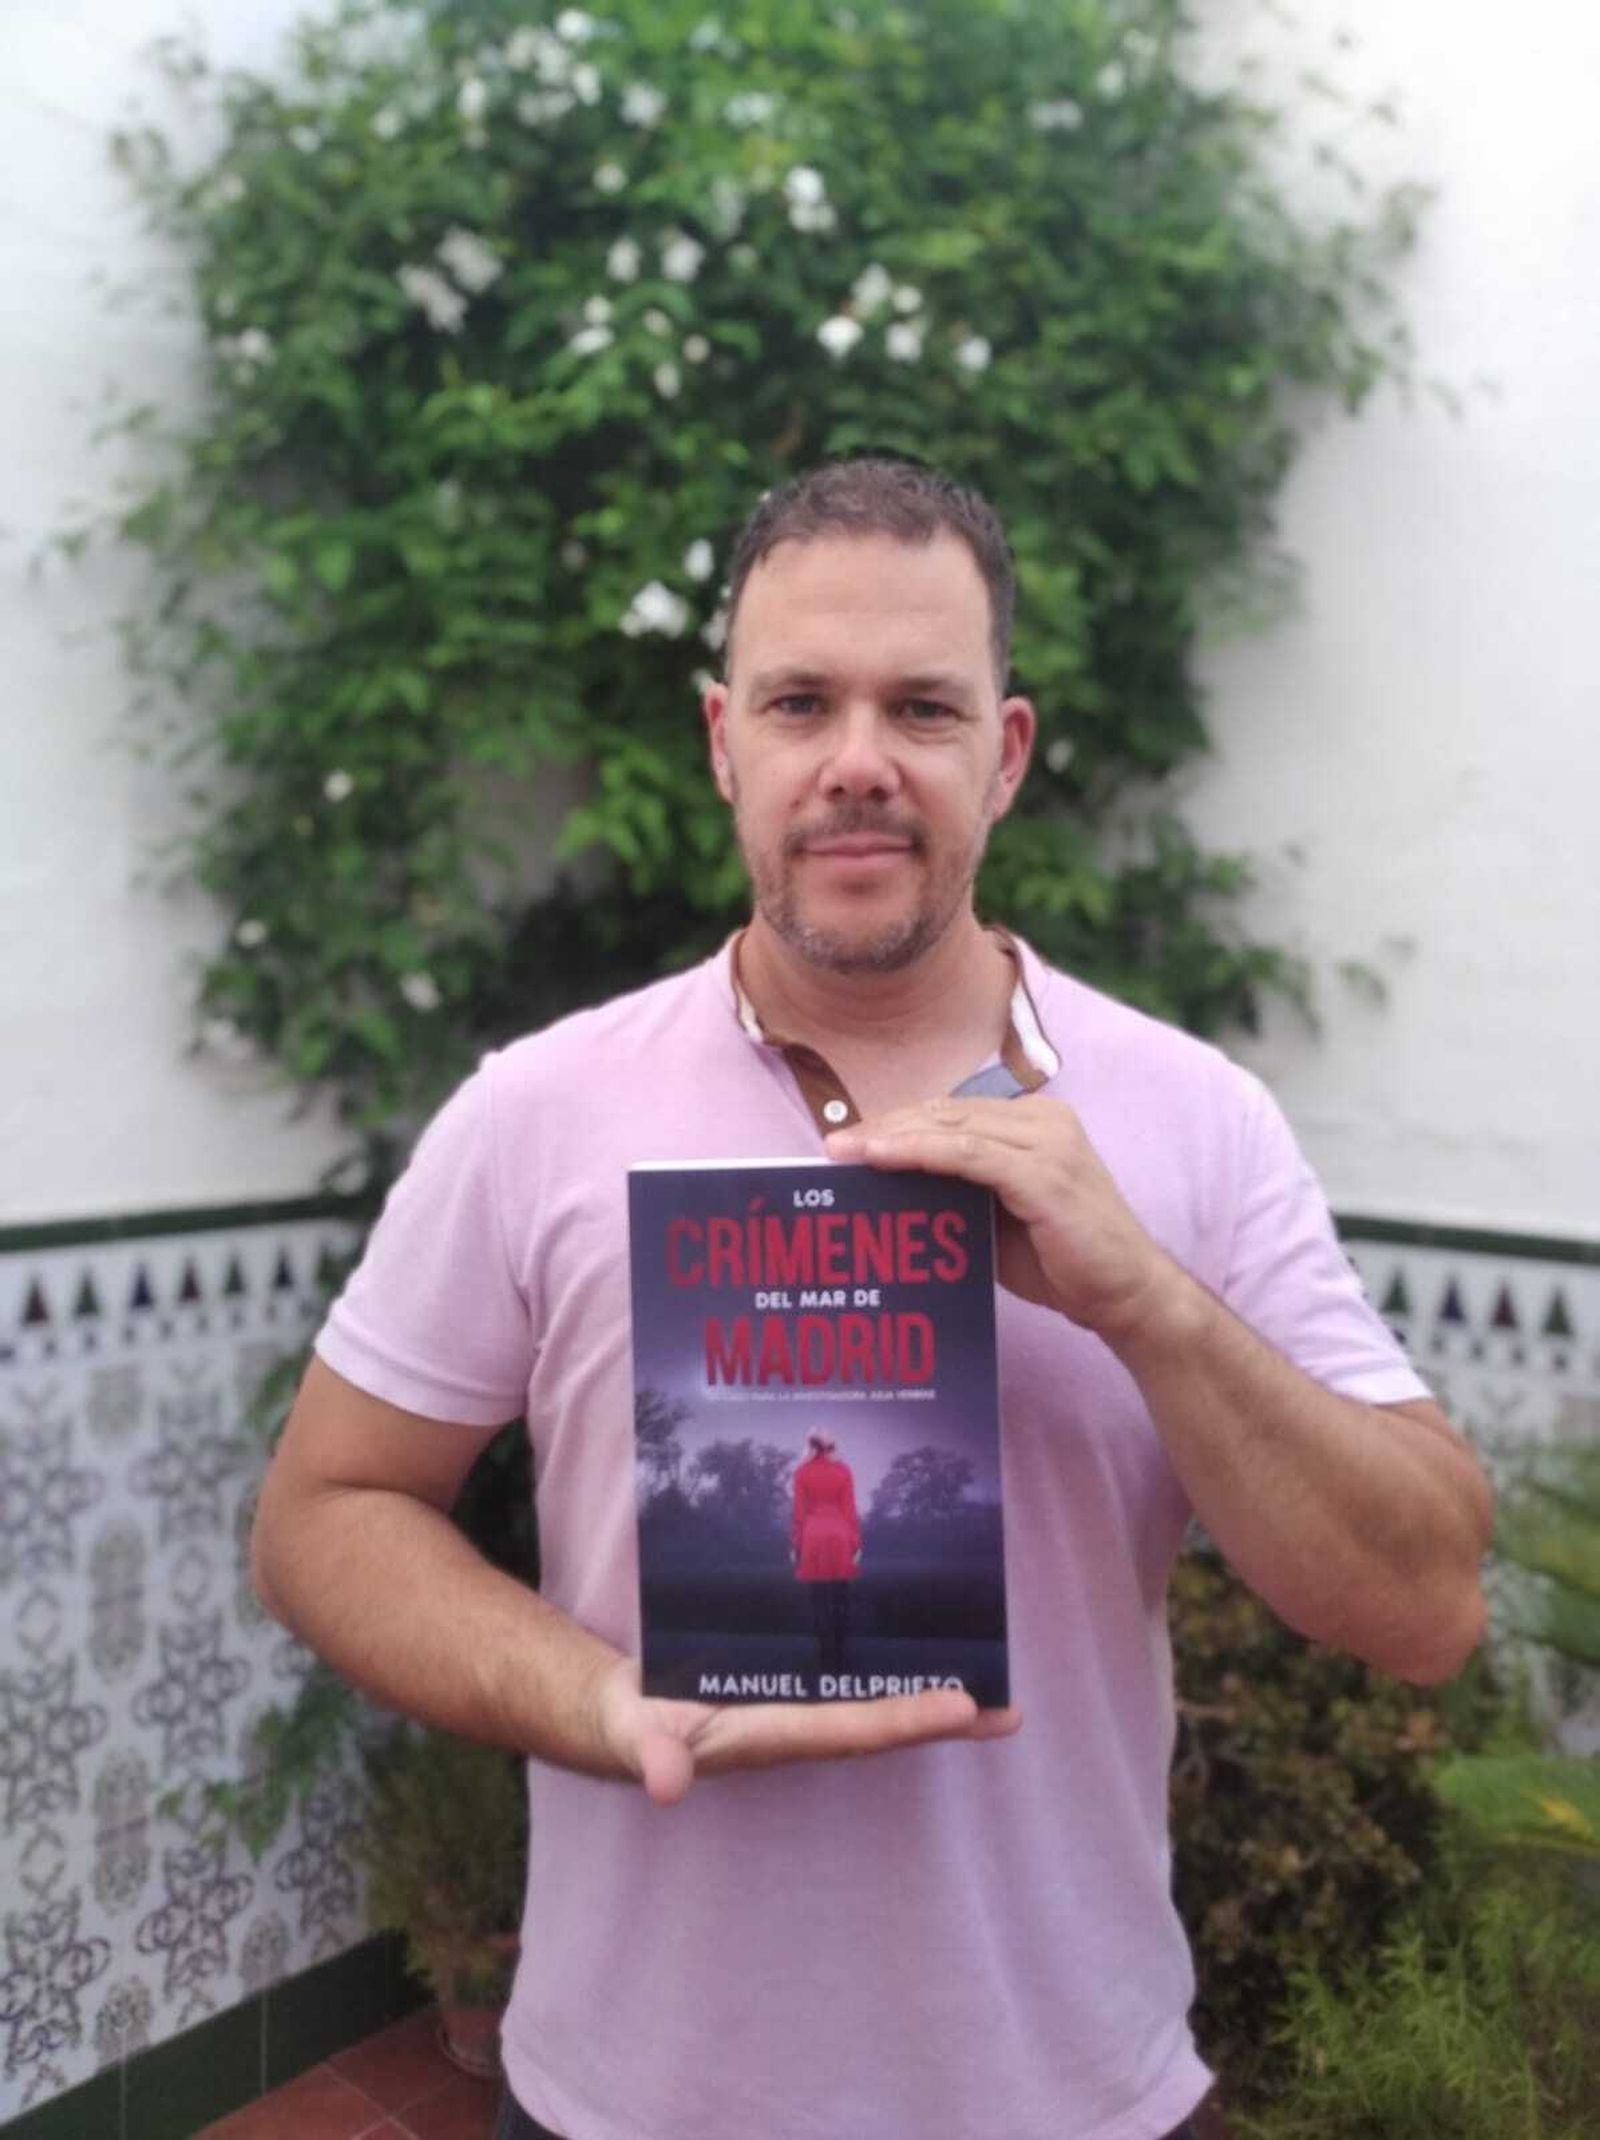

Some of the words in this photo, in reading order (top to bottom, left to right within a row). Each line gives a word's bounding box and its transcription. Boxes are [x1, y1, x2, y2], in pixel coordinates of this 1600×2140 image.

[793, 1189, 835, 1207] LOS
[665, 1196, 969, 1289] CRÍMENES
[755, 1292, 792, 1309] DEL
[800, 1290, 846, 1308] MAR
[854, 1289, 882, 1307] DE
[704, 1312, 937, 1387] MADRID
[699, 1674, 808, 1697] MANUEL
